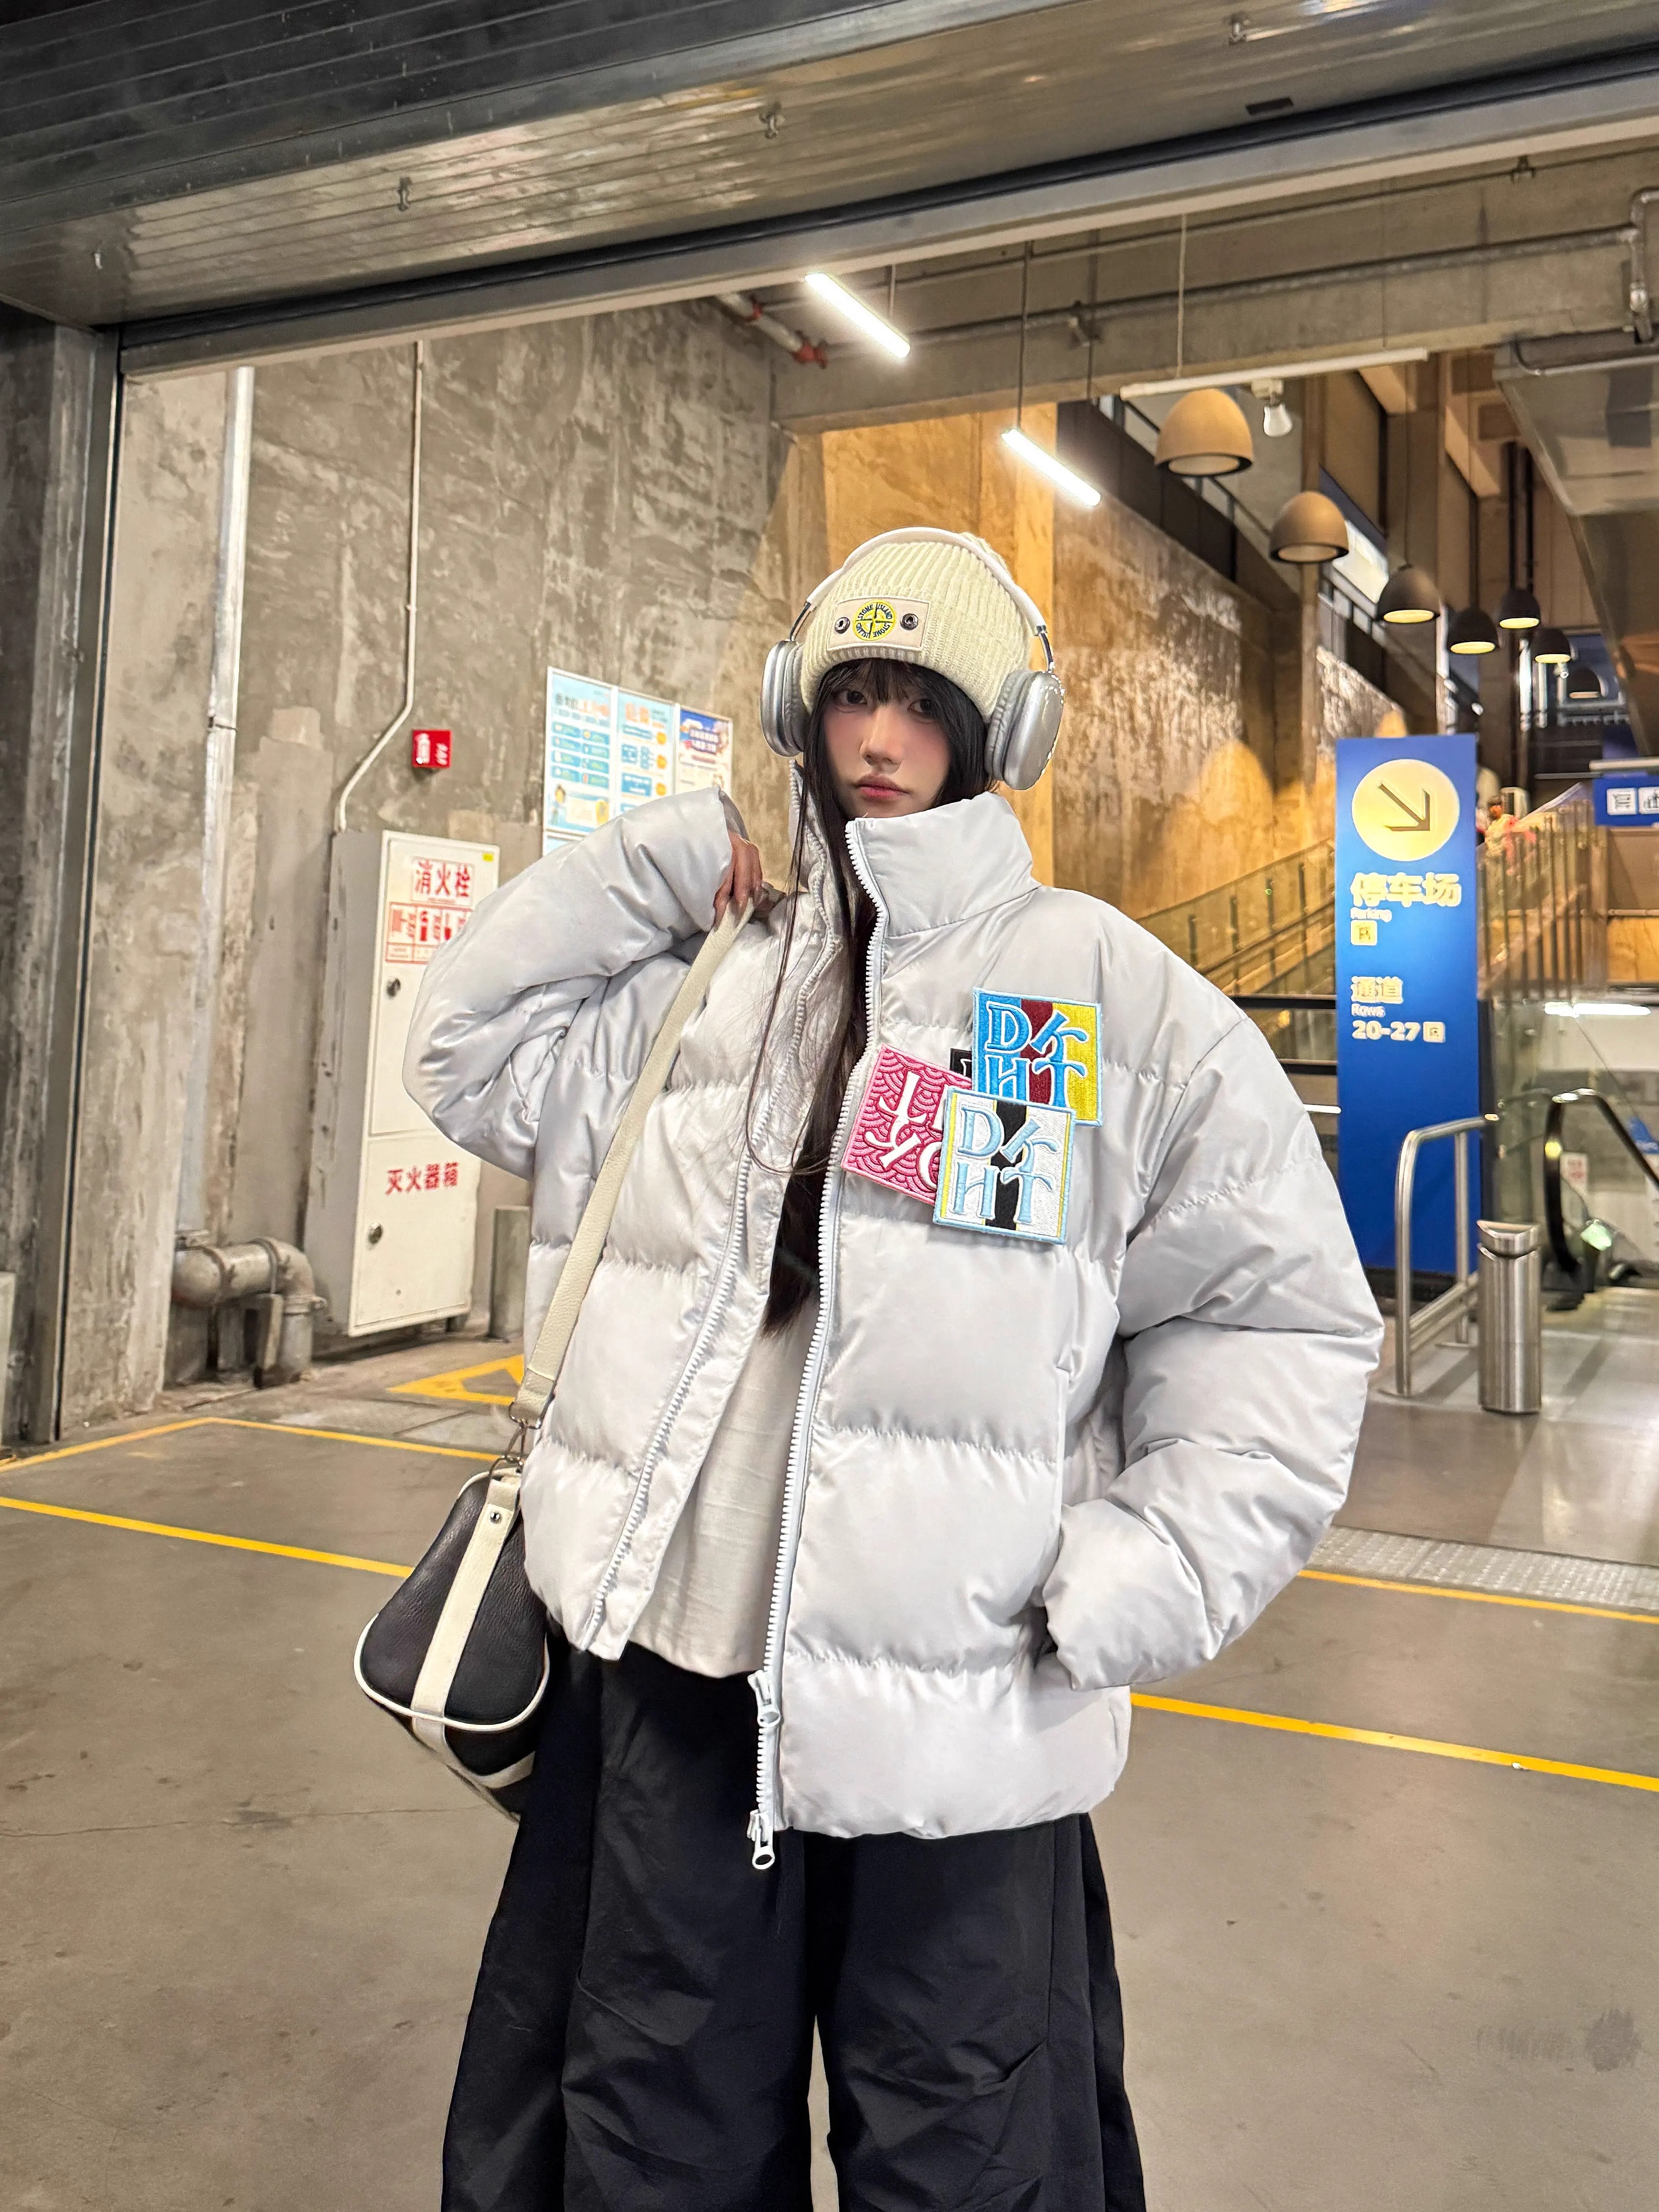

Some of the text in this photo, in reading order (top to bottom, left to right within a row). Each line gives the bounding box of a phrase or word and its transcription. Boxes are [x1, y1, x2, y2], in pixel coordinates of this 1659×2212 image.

[414, 859, 470, 898] 消火栓
[1350, 872, 1462, 907] 停车场
[1350, 976, 1404, 1004] 通道
[1352, 1020, 1421, 1041] 20-27
[385, 1161, 459, 1196] 灭火器箱
